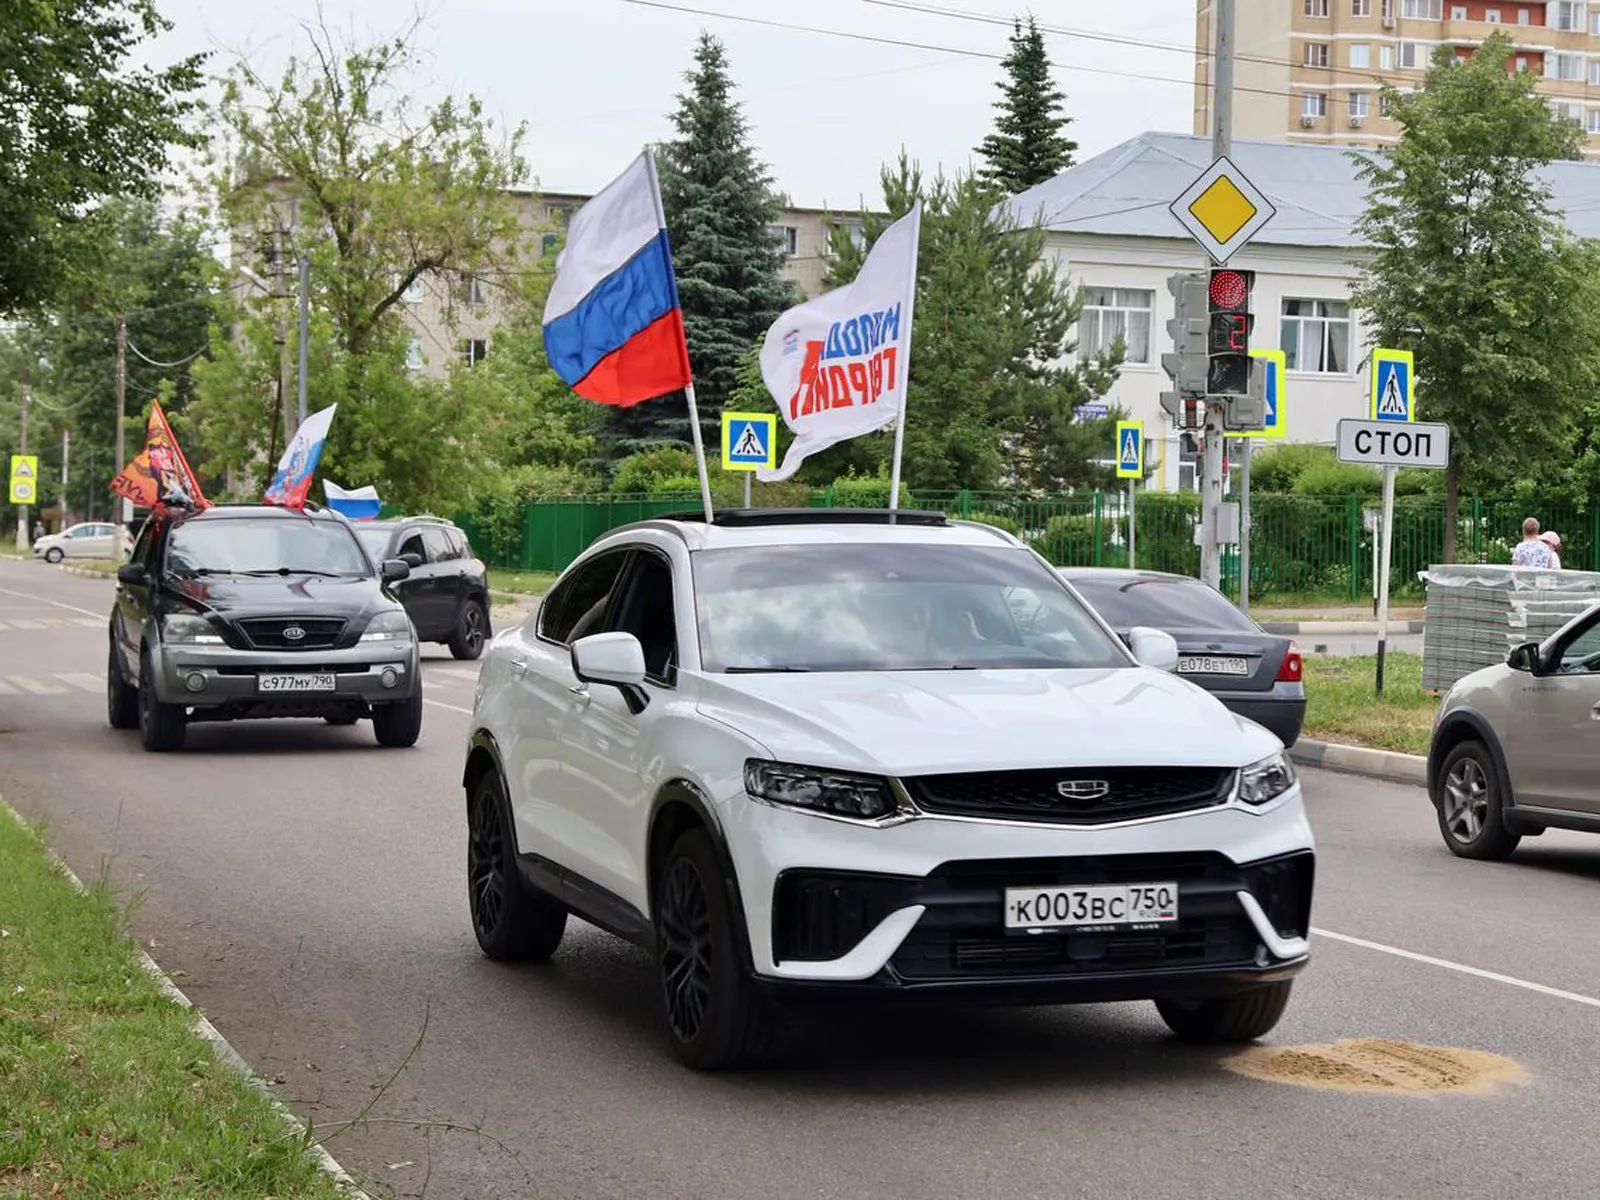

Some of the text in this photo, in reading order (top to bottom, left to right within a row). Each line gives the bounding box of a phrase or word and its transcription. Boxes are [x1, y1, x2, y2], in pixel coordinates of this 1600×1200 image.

[1230, 315, 1246, 349] 2
[1355, 430, 1431, 457] СТОП
[262, 676, 311, 689] С977МУ
[1017, 888, 1170, 922] К003ВС 750
